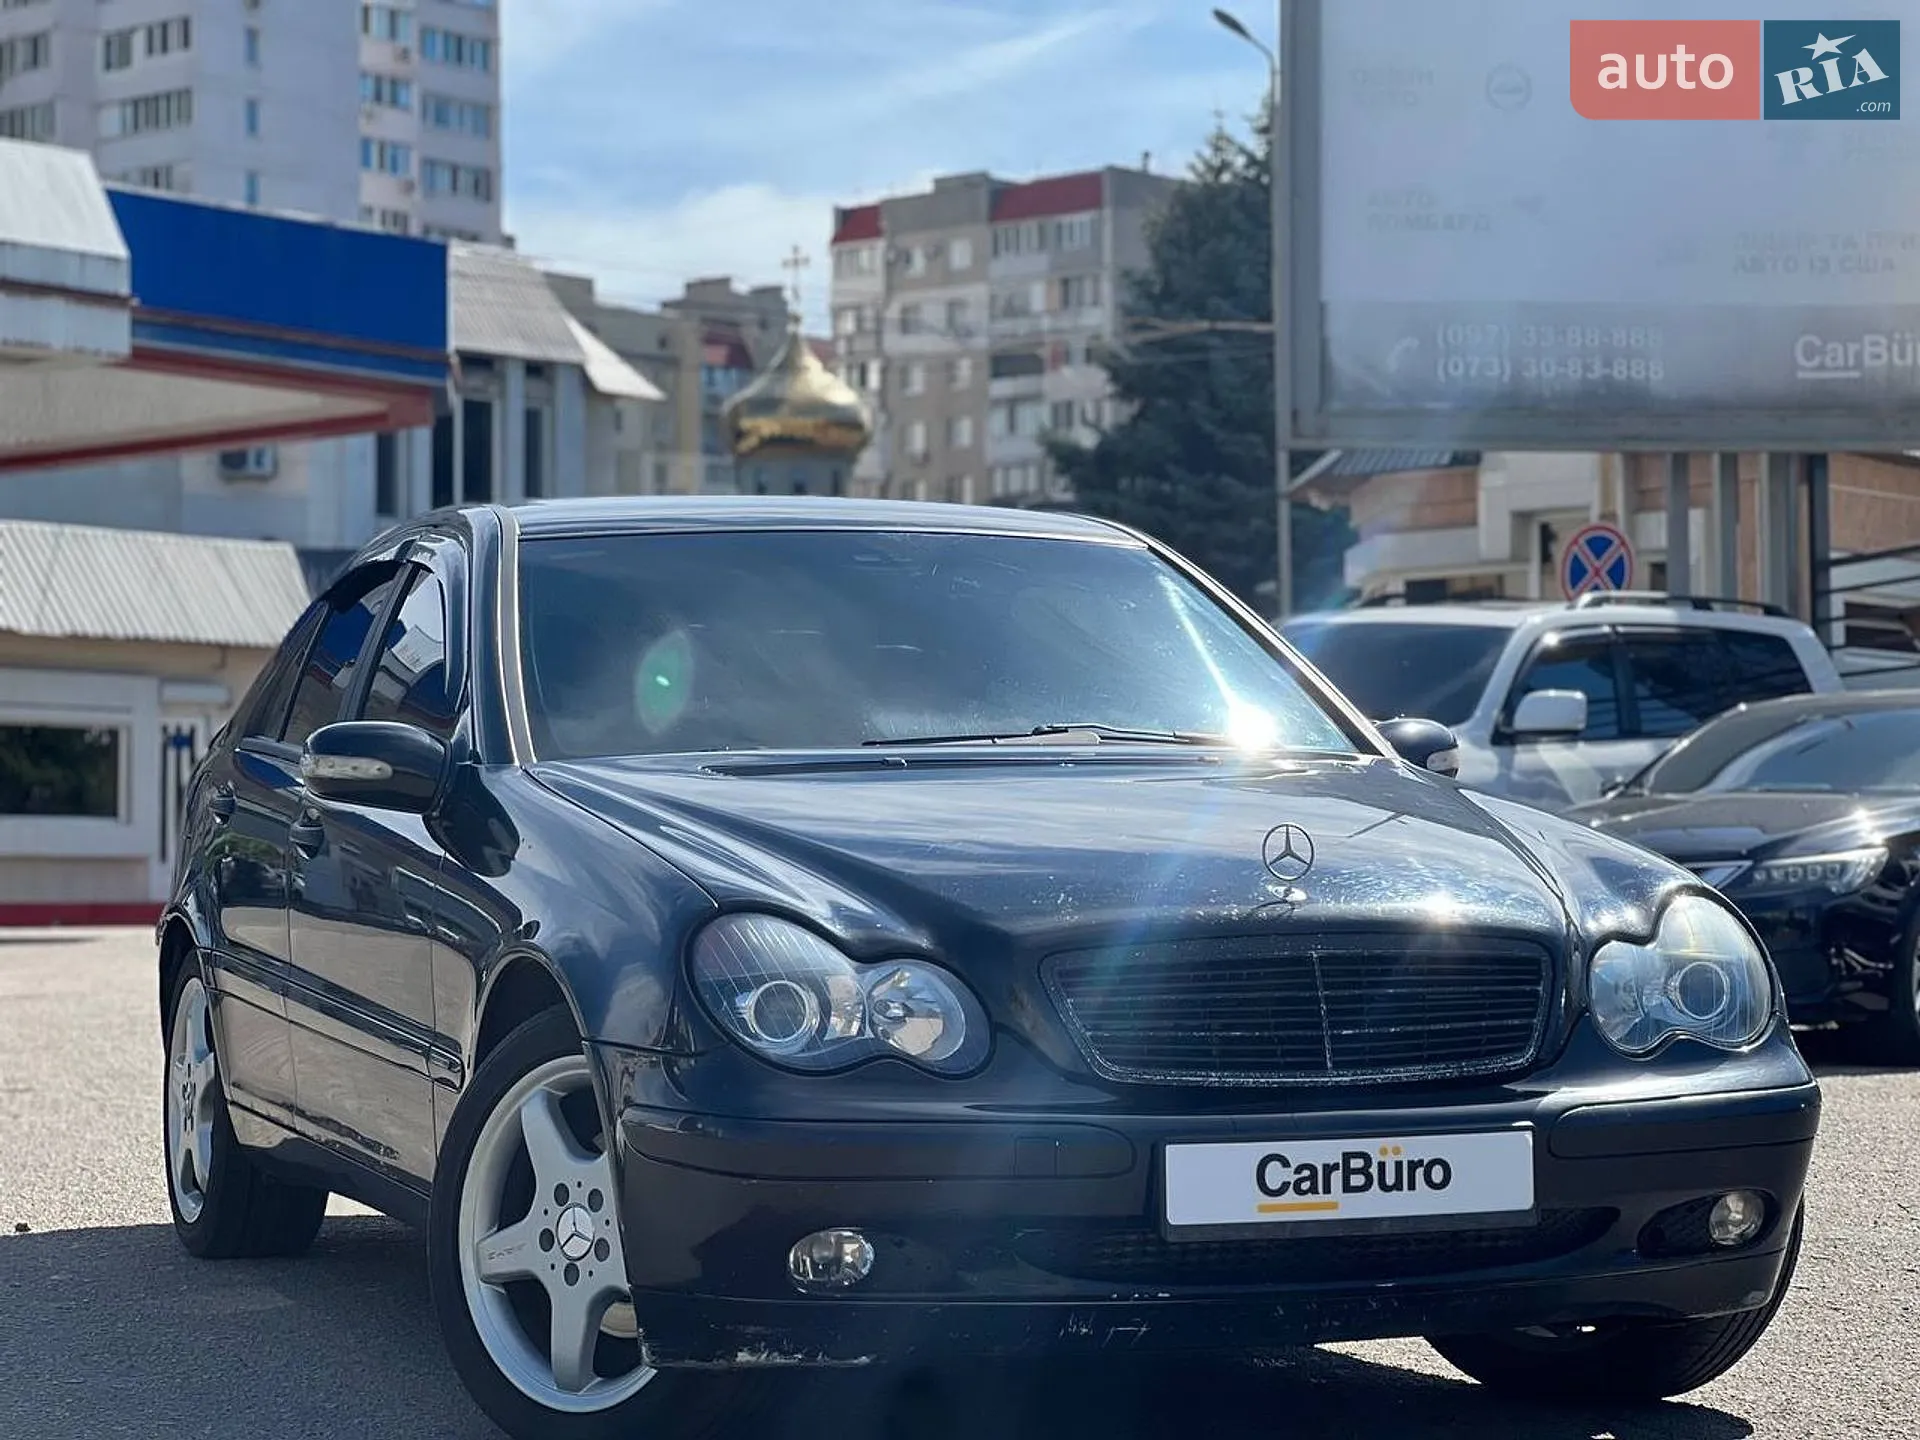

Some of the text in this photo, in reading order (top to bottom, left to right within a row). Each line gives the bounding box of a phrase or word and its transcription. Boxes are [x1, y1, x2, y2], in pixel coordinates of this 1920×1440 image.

[1795, 332, 1920, 368] CarBü
[1436, 356, 1665, 382] (073) 30-83-888
[1256, 1144, 1452, 1198] CarBüro
